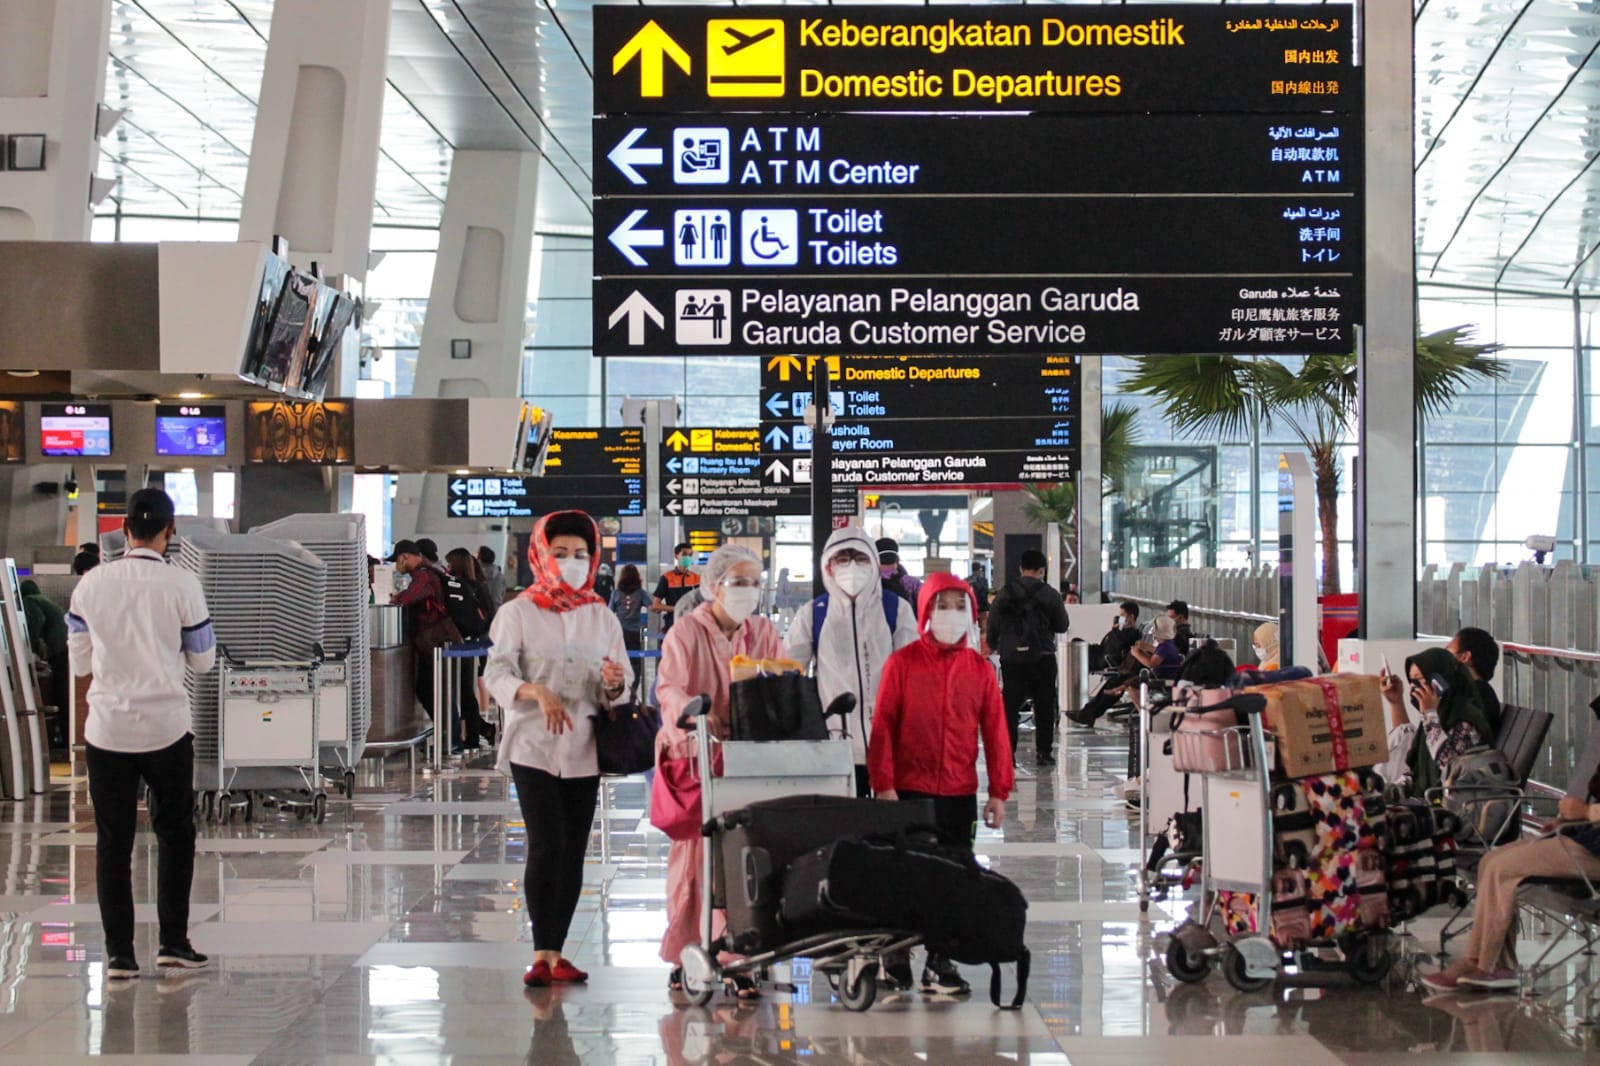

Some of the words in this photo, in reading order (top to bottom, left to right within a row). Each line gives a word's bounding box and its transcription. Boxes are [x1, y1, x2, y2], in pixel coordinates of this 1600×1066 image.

[800, 18, 1032, 54] Keberangkatan
[1042, 17, 1185, 46] Domestik
[1284, 49, 1340, 64] 国内出发
[800, 68, 943, 98] Domestic
[952, 68, 1122, 104] Departures
[1271, 80, 1340, 95] 国内線出発
[1271, 147, 1340, 162] 自动取款机
[827, 158, 921, 185] Center
[807, 207, 884, 235] Toilet
[1299, 227, 1341, 242] 洗手间
[807, 239, 899, 267] Toilets
[1301, 248, 1341, 263] トイレ
[1239, 288, 1279, 300] Garuda
[742, 287, 881, 318] Pelayanan
[890, 286, 1032, 318] Pelanggan
[1040, 287, 1140, 312] Garuda
[742, 320, 842, 346] Garuda
[849, 319, 980, 345] Customer
[987, 319, 1086, 344] Service
[1219, 327, 1341, 342] ガルダ顧客サービス
[845, 366, 906, 381] Domestic
[908, 366, 980, 382] Departures
[848, 390, 880, 403] Toilet
[74, 406, 86, 415] LG
[189, 407, 201, 416] LG
[848, 404, 886, 416] Toilets
[832, 438, 858, 451] ayer
[860, 437, 894, 450] Room
[882, 457, 942, 470] Pelanggan
[944, 455, 987, 468] Garuda
[832, 470, 863, 482] aruda
[865, 469, 919, 482] Customer
[922, 469, 964, 481] Service
[728, 486, 763, 495] Customer
[763, 486, 791, 495] Service
